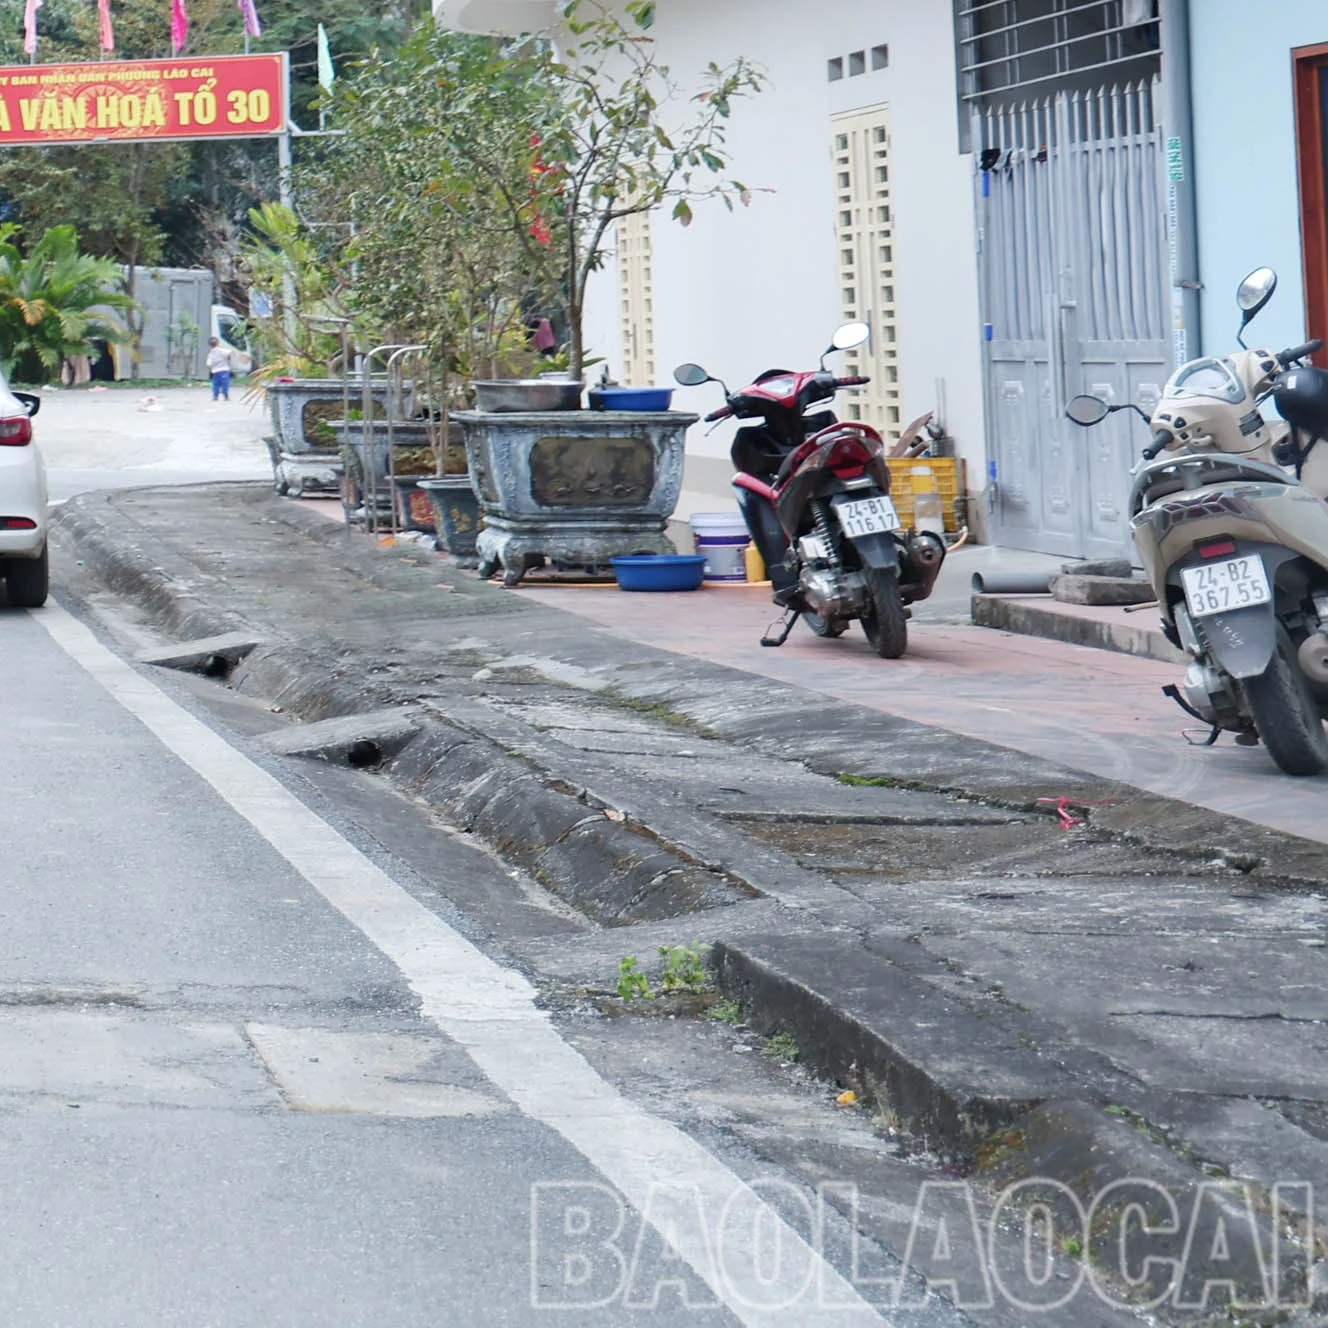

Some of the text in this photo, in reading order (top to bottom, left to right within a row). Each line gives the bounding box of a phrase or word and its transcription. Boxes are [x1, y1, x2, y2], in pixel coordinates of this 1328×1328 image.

[11, 75, 38, 86] BAN
[191, 67, 215, 78] CAI
[20, 92, 88, 131] VĂN
[96, 87, 166, 128] HOÁ
[174, 77, 218, 126] TỔ
[227, 89, 271, 124] 30
[845, 498, 886, 519] 24-B1
[1194, 559, 1252, 590] 24-B2
[1192, 579, 1265, 613] 367.55
